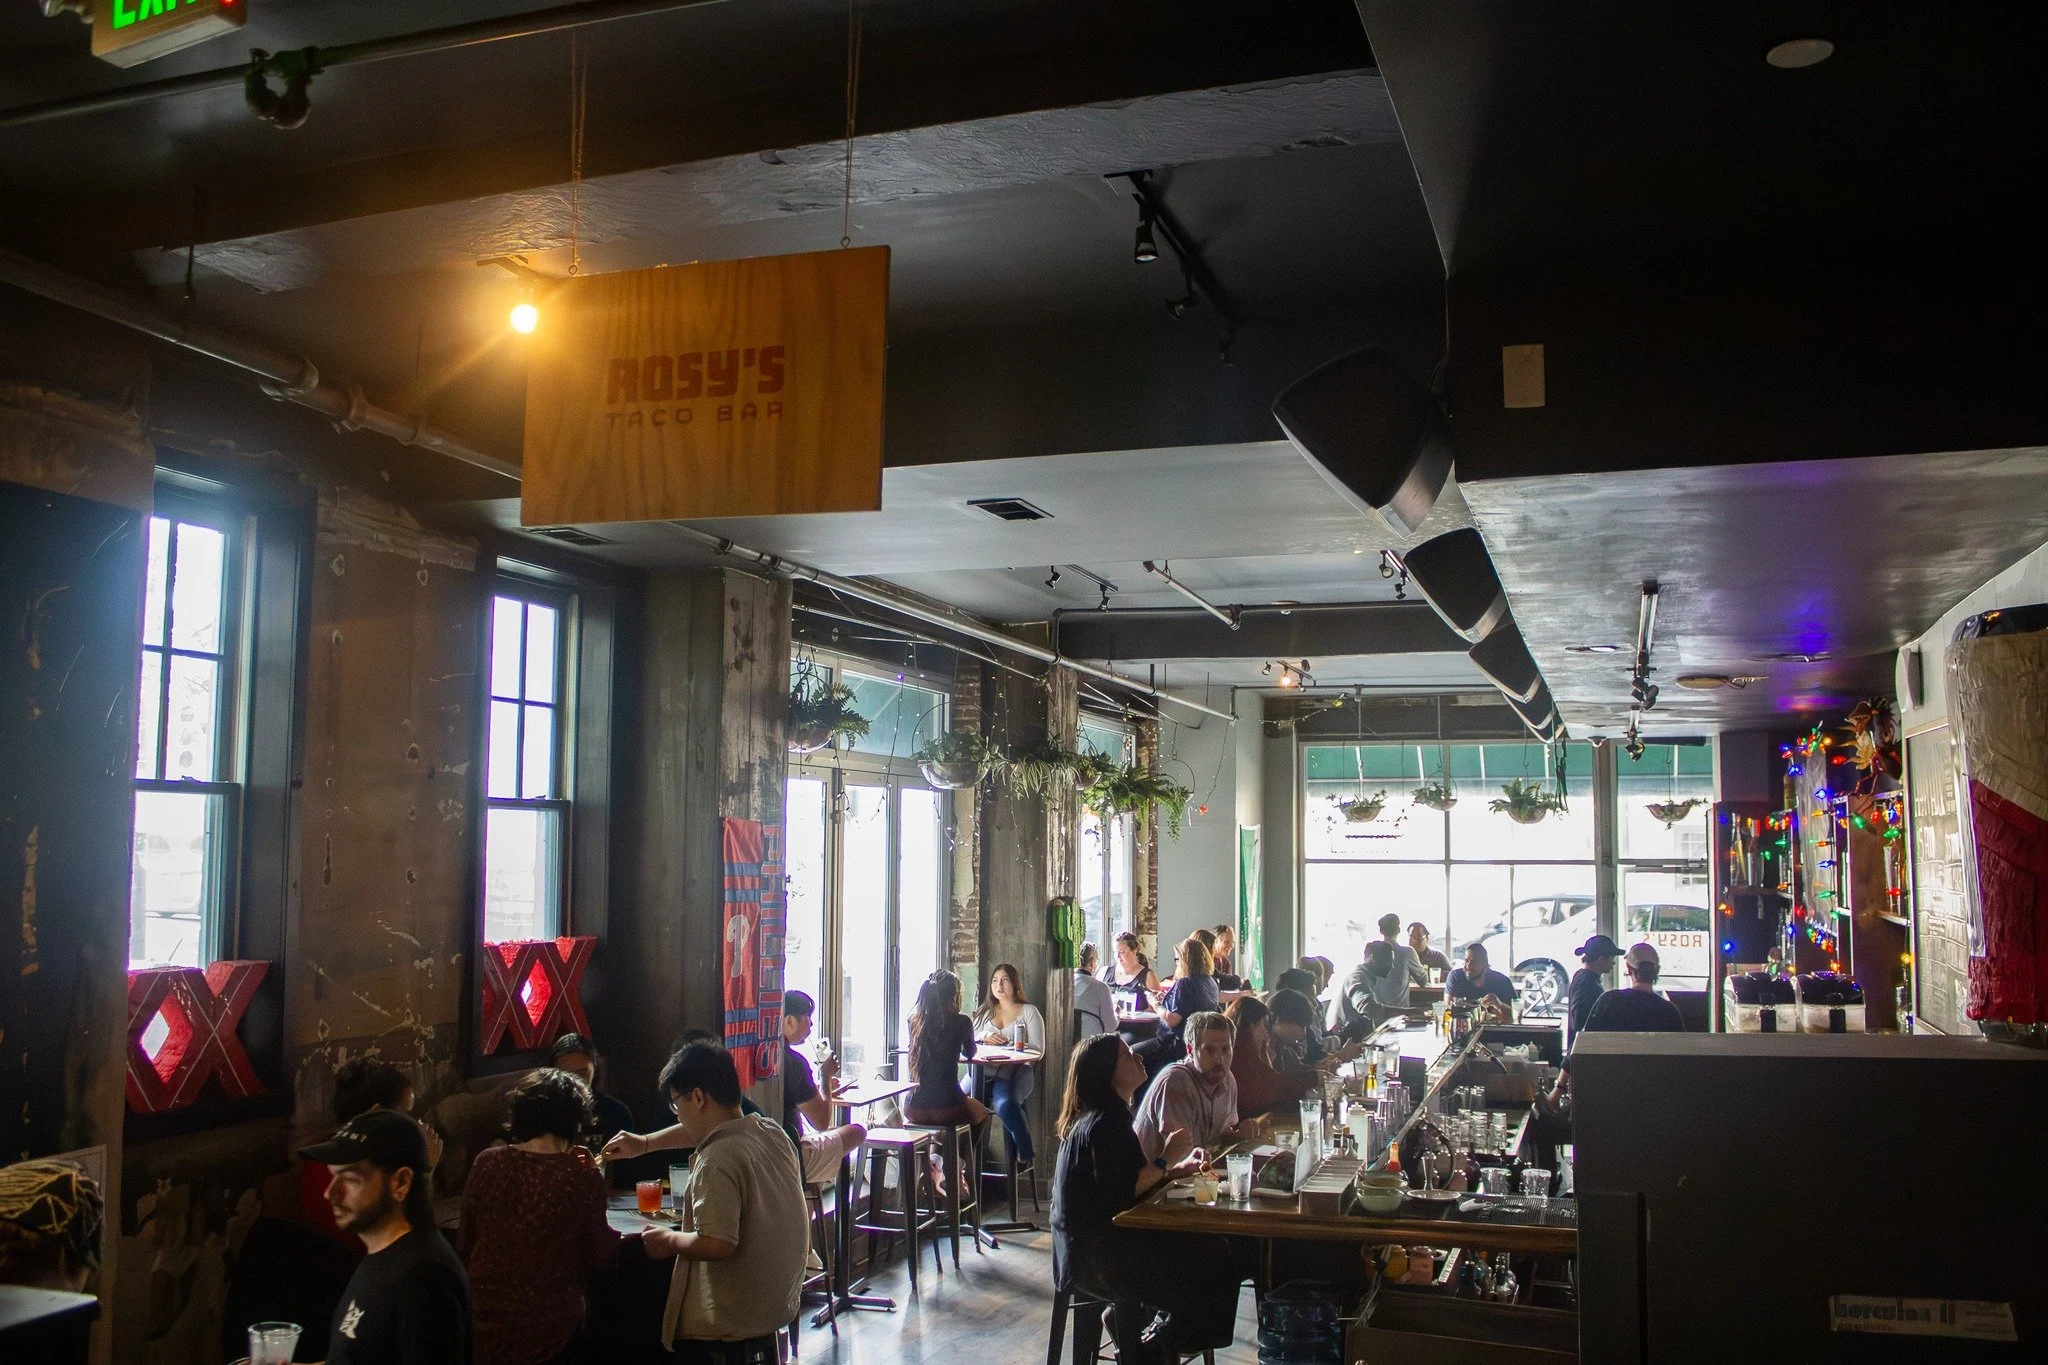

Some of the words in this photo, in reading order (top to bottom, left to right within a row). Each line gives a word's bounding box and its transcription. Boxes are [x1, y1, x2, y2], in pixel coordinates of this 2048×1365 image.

[607, 345, 785, 405] ROSY'S
[604, 409, 693, 428] TACO
[717, 402, 783, 423] BAR
[755, 824, 785, 1079] PHILLIES
